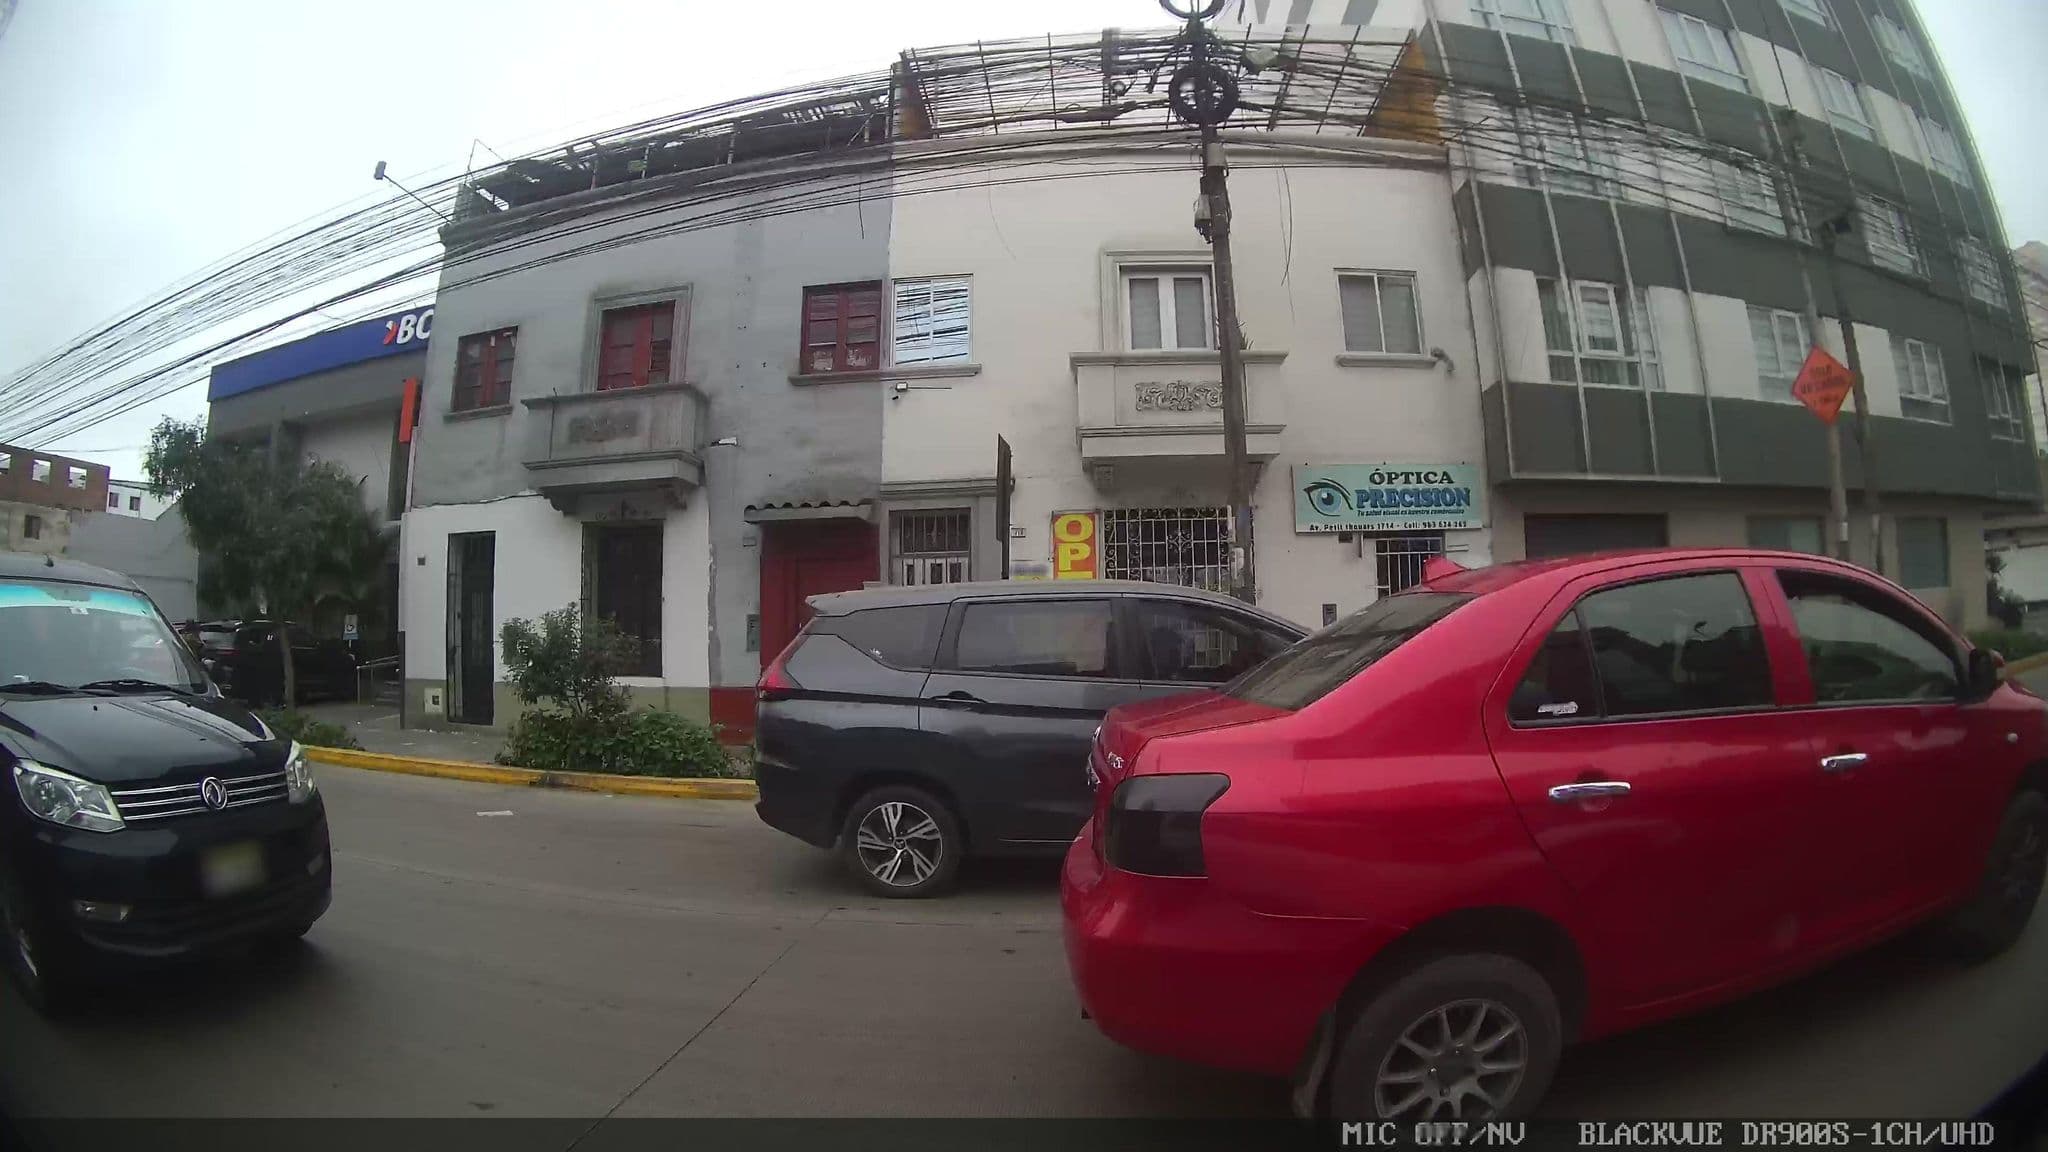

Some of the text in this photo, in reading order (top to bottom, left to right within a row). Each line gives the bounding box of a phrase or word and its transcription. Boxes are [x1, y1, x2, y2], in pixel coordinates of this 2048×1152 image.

[1369, 468, 1454, 485] ÓPTICA
[1355, 487, 1471, 508] PRECISION
[1055, 514, 1094, 579] OP
